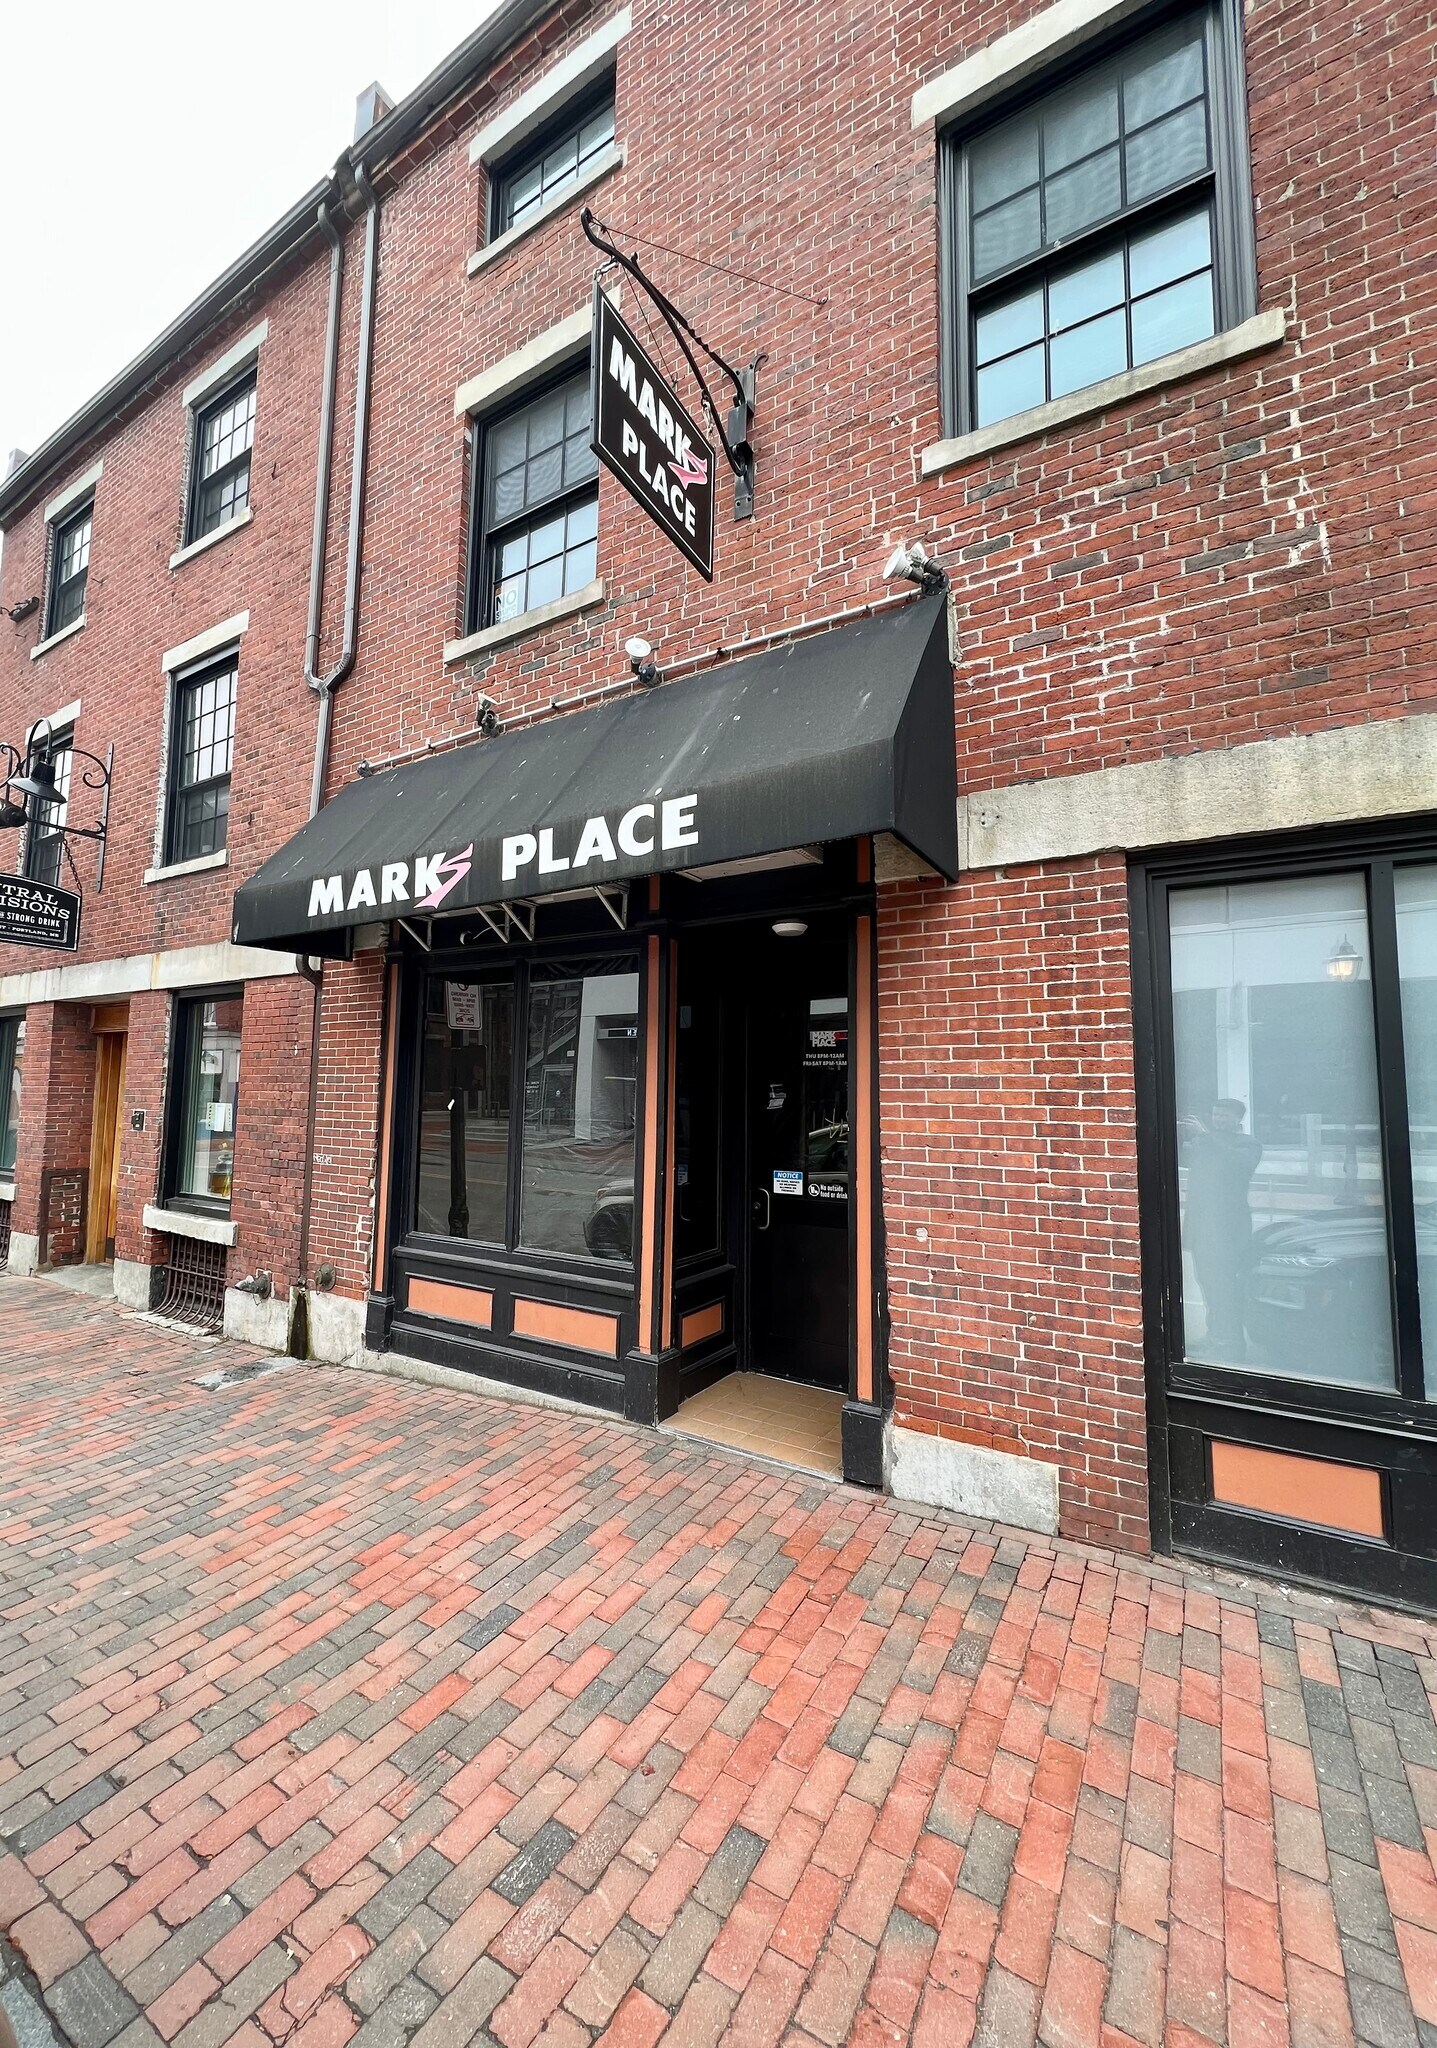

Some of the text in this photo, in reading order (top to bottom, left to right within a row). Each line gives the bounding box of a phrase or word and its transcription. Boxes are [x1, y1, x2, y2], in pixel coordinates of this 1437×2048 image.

[622, 418, 696, 538] PLACE
[501, 793, 699, 882] PLACE
[0, 883, 58, 905] TRAL
[6, 911, 36, 924] STRONG
[38, 917, 61, 928] DRINK
[811, 1038, 837, 1047] PLACE
[777, 1171, 799, 1179] NOTICE
